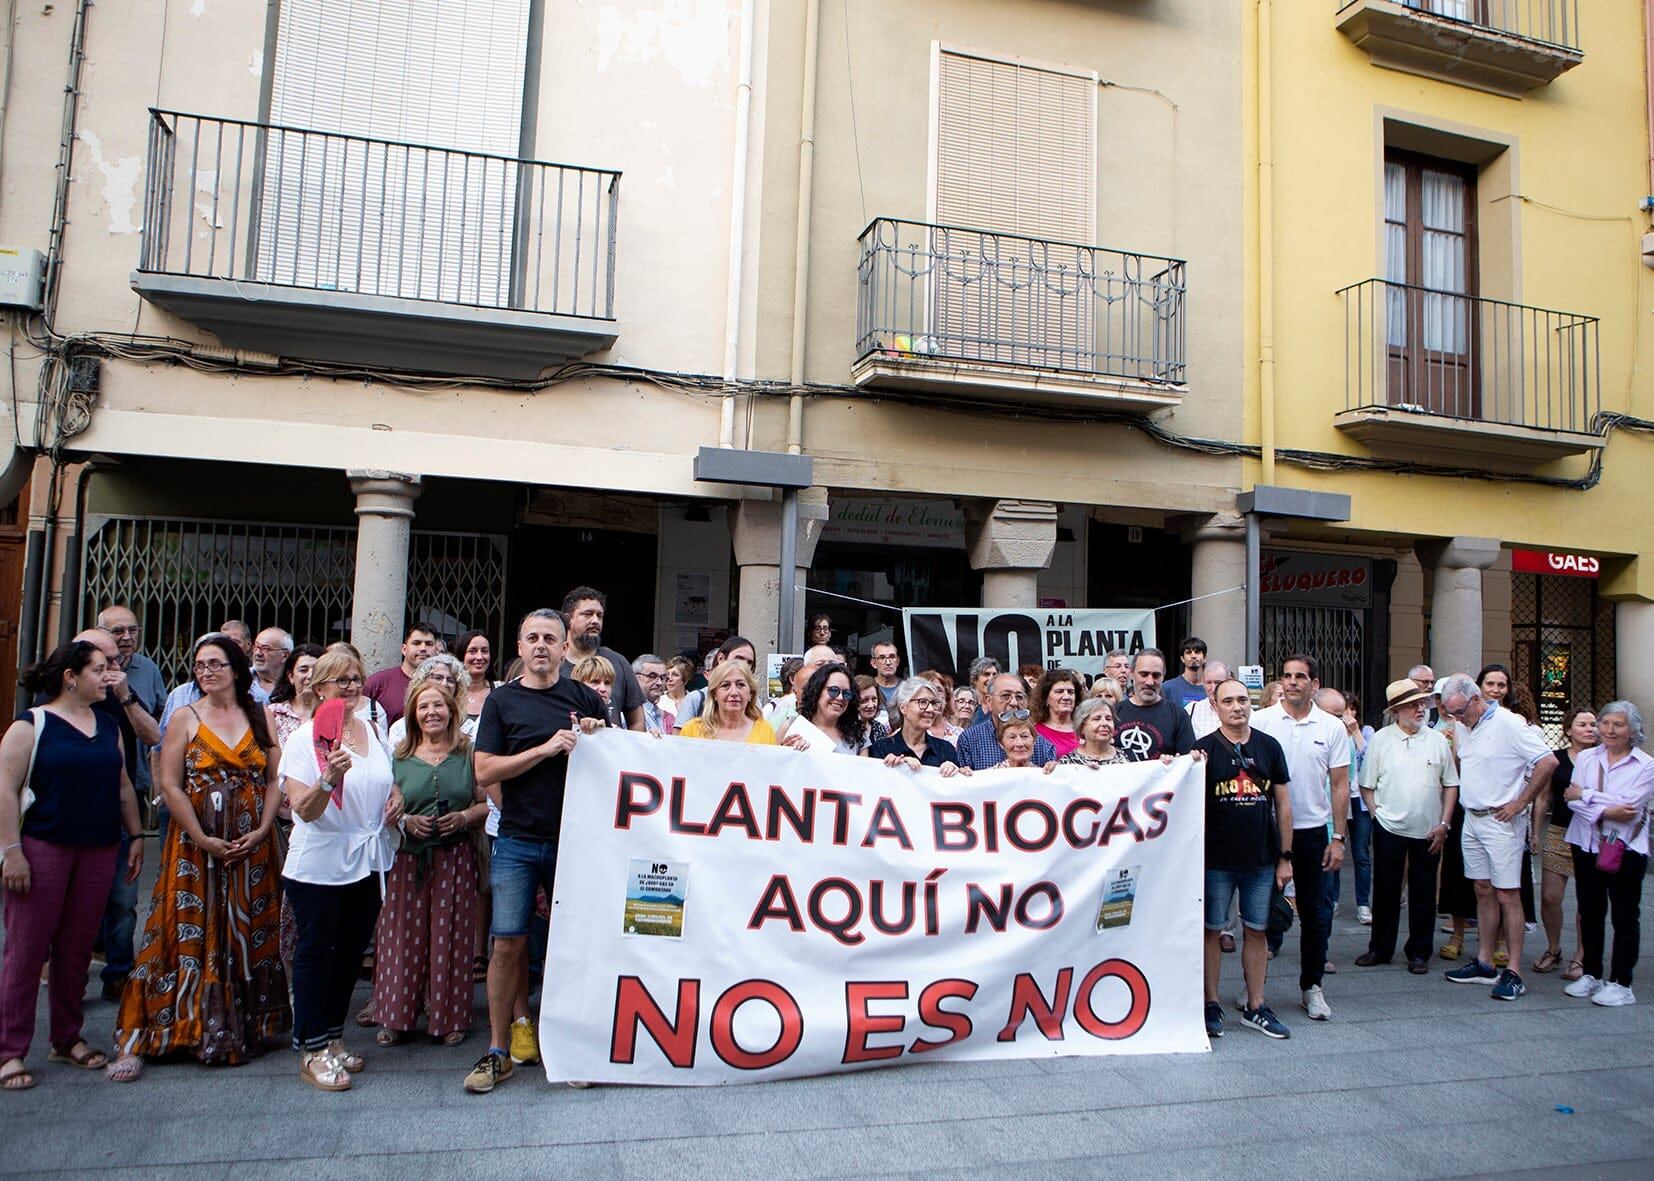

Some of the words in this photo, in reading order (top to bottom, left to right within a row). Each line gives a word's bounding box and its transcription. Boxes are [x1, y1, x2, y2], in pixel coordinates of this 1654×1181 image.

[886, 507, 903, 524] de
[581, 531, 593, 542] 14
[1548, 553, 1600, 572] GAES
[1260, 567, 1367, 594] ELUQUERO
[1046, 614, 1055, 627] A
[1058, 614, 1073, 627] LA
[1046, 630, 1145, 657] PLANTA
[614, 771, 915, 850] PLANTA
[929, 792, 1174, 853] BIOGAS
[747, 868, 949, 946] AQUÍ
[964, 881, 1065, 935] NO
[609, 975, 804, 1070] NO
[841, 978, 979, 1064] ES
[996, 958, 1151, 1043] NO
